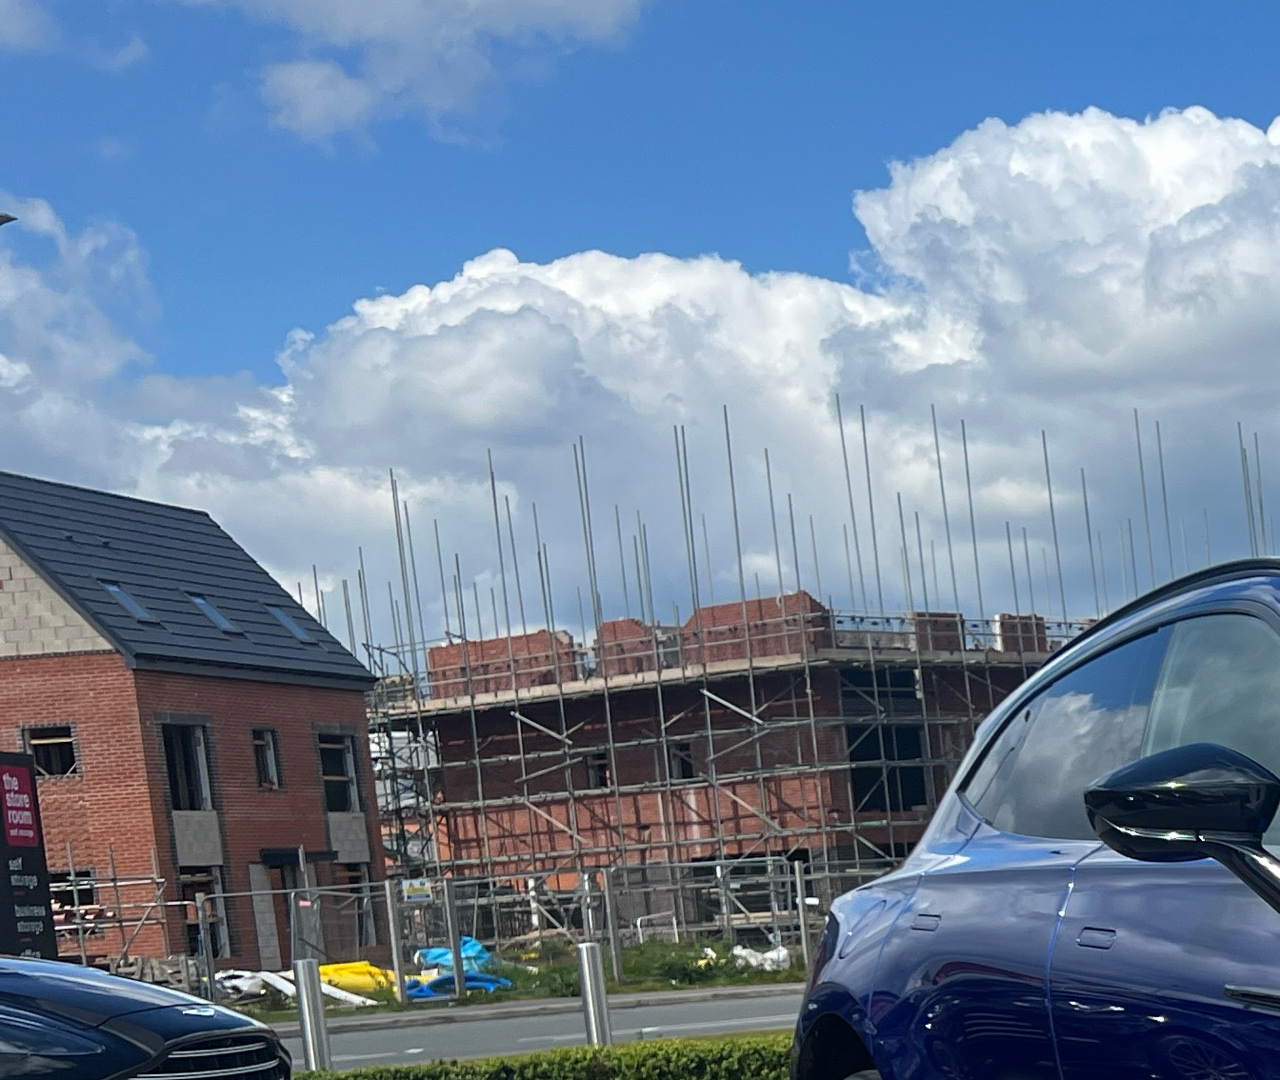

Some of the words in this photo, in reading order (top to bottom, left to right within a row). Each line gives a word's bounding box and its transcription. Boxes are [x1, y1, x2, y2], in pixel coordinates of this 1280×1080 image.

[2, 772, 19, 791] the
[5, 791, 30, 808] store
[7, 809, 33, 825] room
